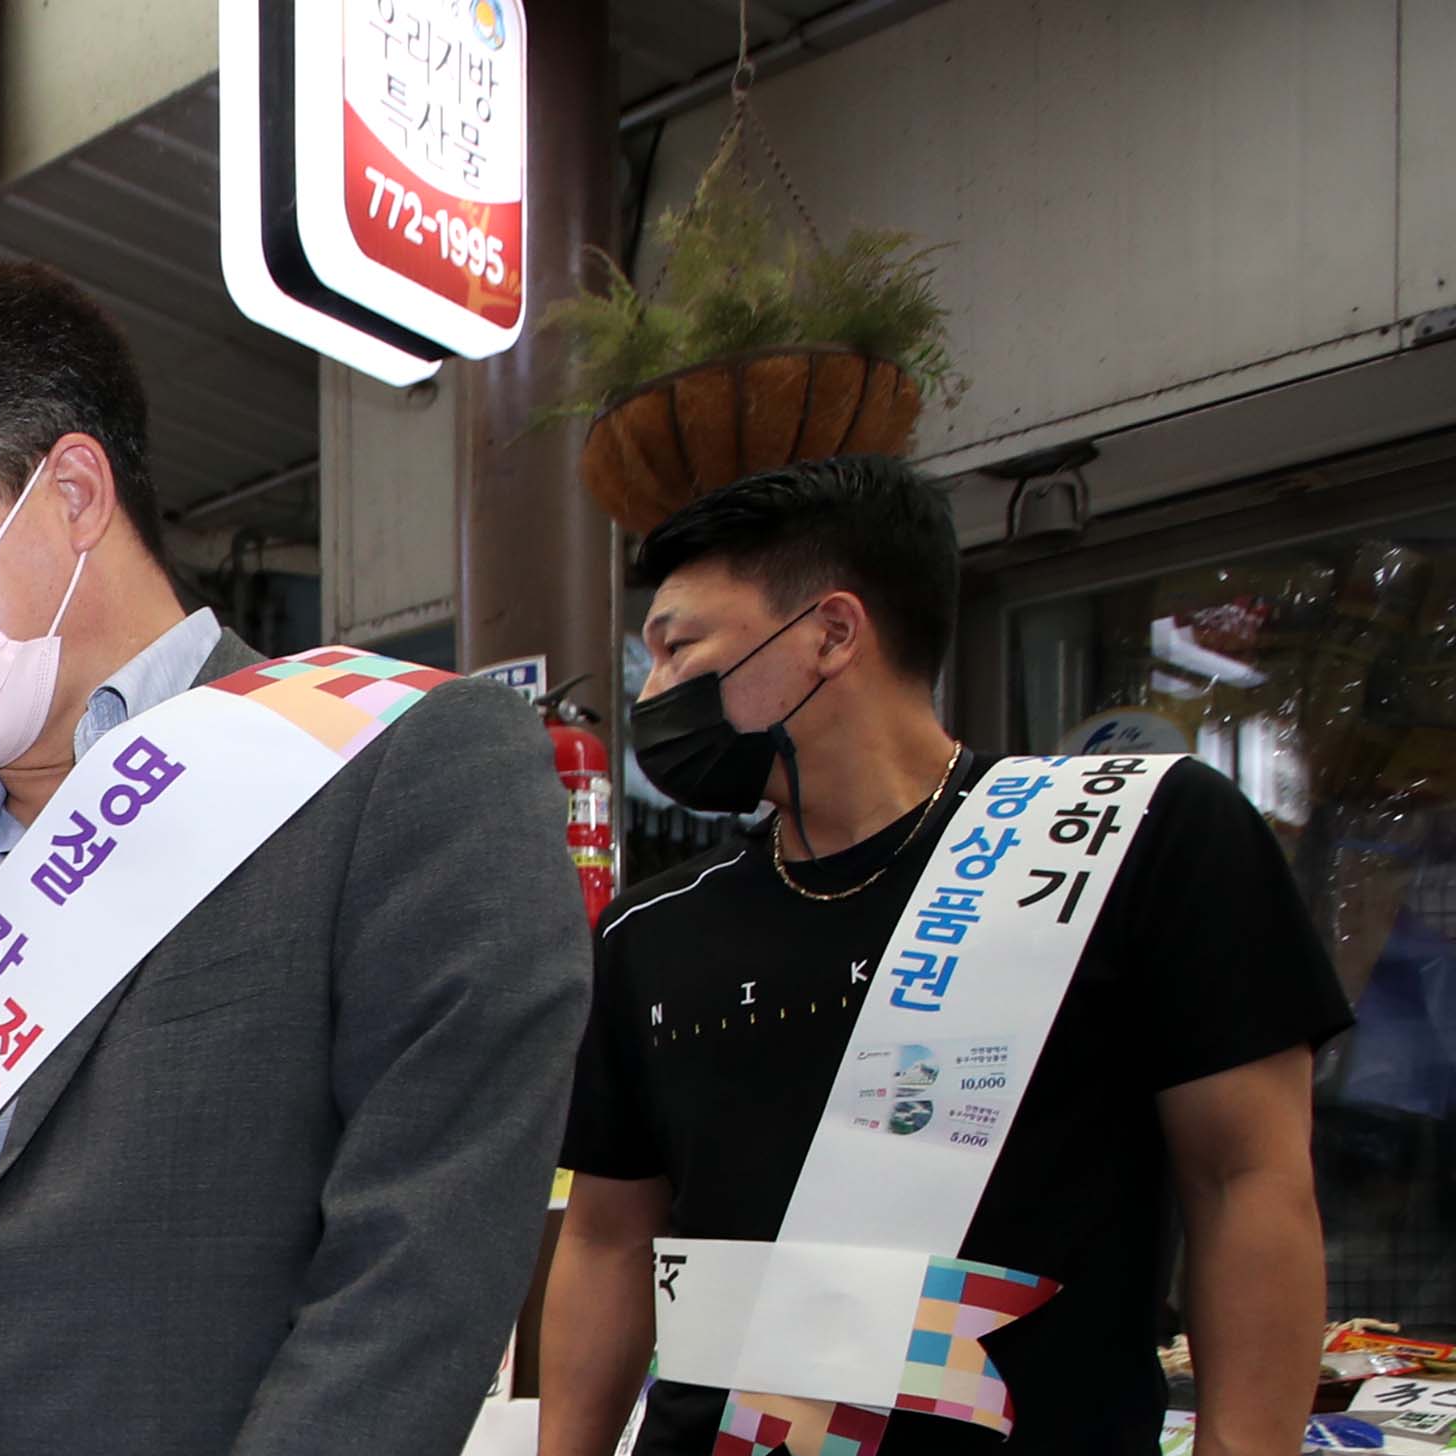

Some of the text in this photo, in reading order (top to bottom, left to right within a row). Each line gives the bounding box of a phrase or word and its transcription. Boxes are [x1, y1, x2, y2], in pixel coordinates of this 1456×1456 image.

[380, 72, 488, 191] 특산물
[364, 166, 506, 287] 772-1995
[29, 734, 187, 908] 명절
[1016, 756, 1149, 925] 용하기
[949, 1130, 989, 1148] 5,000
[960, 1076, 1006, 1091] 10,000
[652, 1251, 688, 1303] 서
